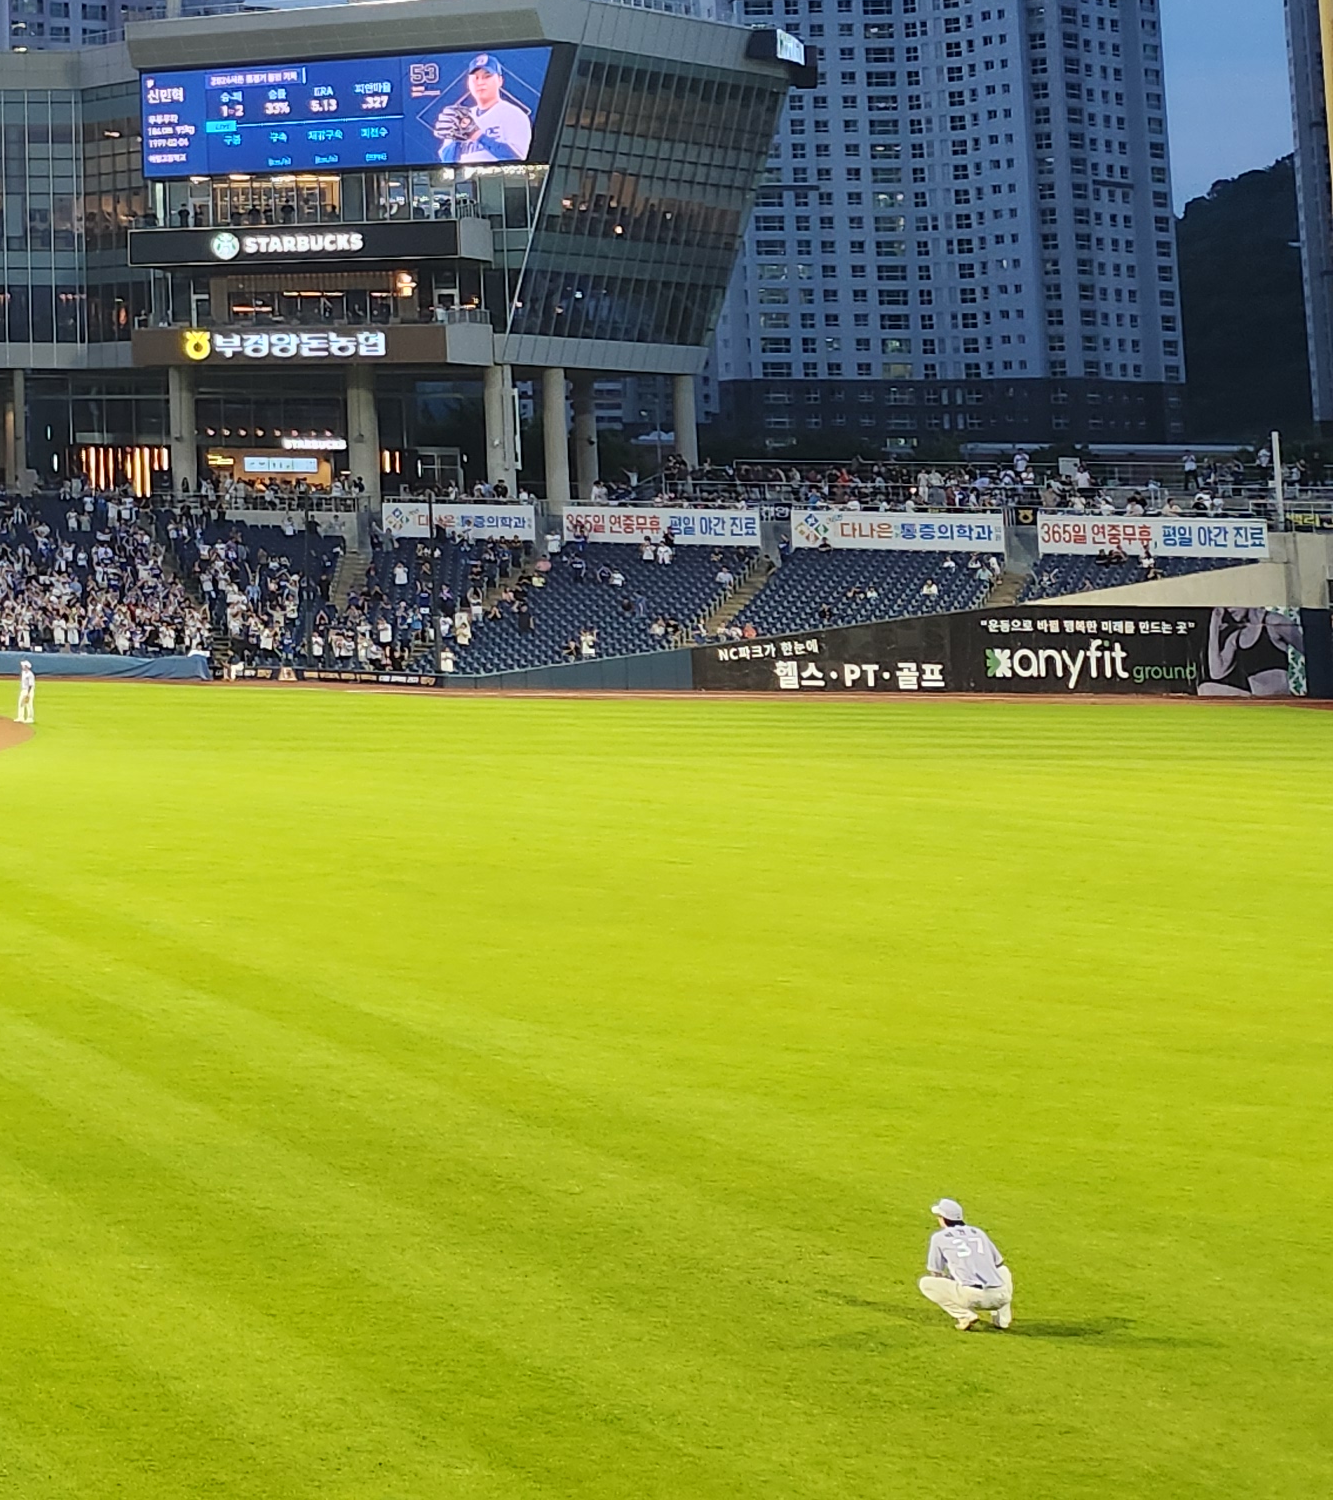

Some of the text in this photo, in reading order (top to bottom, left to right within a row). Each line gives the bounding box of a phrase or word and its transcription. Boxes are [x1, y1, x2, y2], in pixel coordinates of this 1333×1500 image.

[410, 63, 439, 83] 53
[313, 87, 333, 96] ERA
[220, 104, 244, 117] 1-2
[264, 101, 290, 114] 33%
[244, 233, 364, 253] STARBUCKS
[214, 331, 386, 358] 부경양돈농협
[566, 514, 758, 537] 365일 연중무휴 평일 야간 진료
[840, 522, 894, 539] 다나은
[900, 523, 993, 541] 통증의학과
[1041, 523, 1087, 544] 365일
[1162, 525, 1192, 547] 평일
[1198, 526, 1229, 547] 야간
[1233, 526, 1266, 548] 진료
[1101, 620, 1135, 634] 미래를
[1138, 621, 1172, 634] 만드는
[717, 639, 819, 661] NC파크가 한눈에
[1013, 638, 1130, 689] anyfit
[1133, 662, 1197, 683] ground
[952, 1237, 984, 1257] 37
